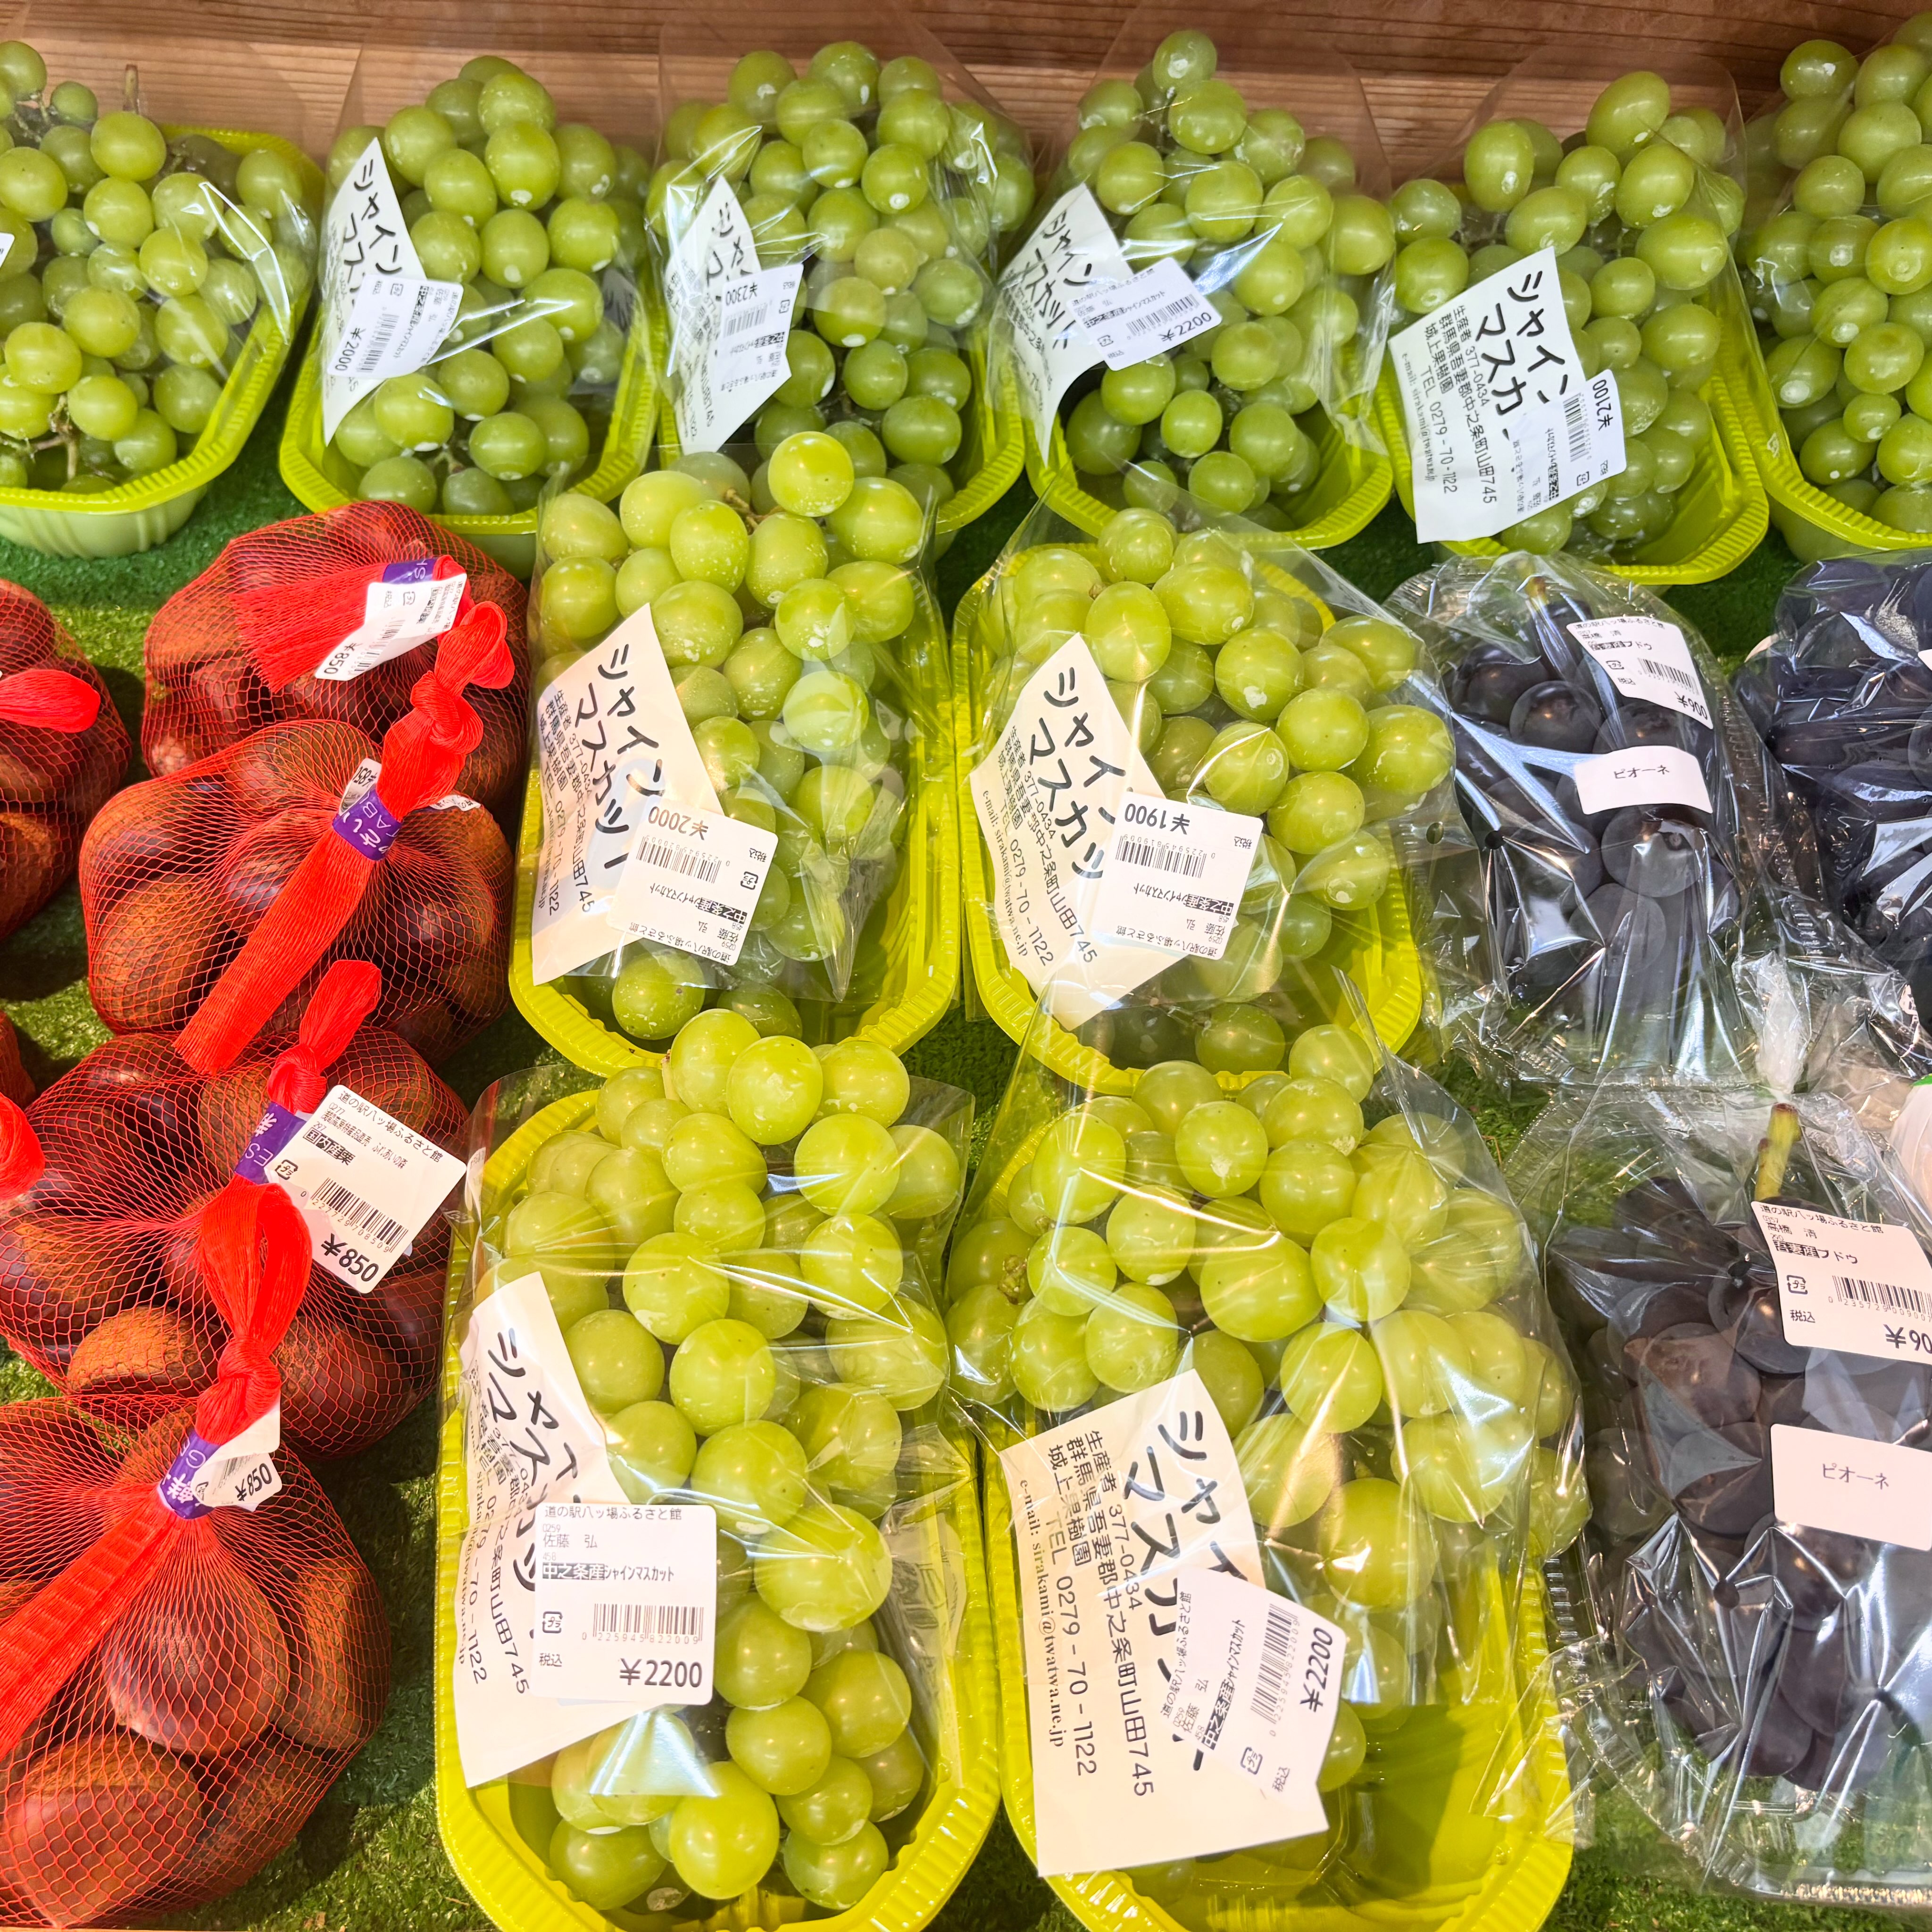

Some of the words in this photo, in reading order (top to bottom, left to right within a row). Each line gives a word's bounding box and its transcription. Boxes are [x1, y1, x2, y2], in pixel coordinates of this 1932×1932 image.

[354, 158, 402, 275] シャイン
[725, 282, 758, 306] ¥2300
[1158, 312, 1212, 341] ¥2200
[334, 327, 366, 371] ¥2000
[1453, 305, 1472, 341] 生産者
[1466, 345, 1491, 407] 377-0434
[1421, 365, 1436, 398] TEL
[1592, 379, 1614, 431] ¥2100
[324, 643, 363, 675] ¥850
[554, 689, 572, 731] 生産者
[598, 643, 666, 797] シャイン
[1674, 691, 1708, 720] ¥900
[542, 764, 554, 799] TEL
[1009, 725, 1025, 769] 生産者
[1024, 771, 1056, 840] 377-0434
[1613, 764, 1670, 780] ピオーネ
[983, 790, 998, 827] e-mail:
[1030, 717, 1104, 879] マスカッ
[648, 806, 708, 841] ¥2000
[999, 800, 1009, 838] TEL
[1124, 803, 1190, 835] ¥1900
[749, 847, 767, 863] 税込
[1233, 836, 1252, 849] 税込
[313, 1121, 327, 1132] 297
[329, 1102, 345, 1116] 0277
[338, 1090, 443, 1162] 道の駅八ッ場ふるさと館
[302, 1126, 356, 1166] 国内産栗
[321, 1232, 379, 1282] ¥850
[1790, 1309, 1815, 1323] 税込
[488, 1327, 581, 1503] シャイ
[235, 1463, 272, 1502] ¥850
[1822, 1463, 1890, 1490] ピオーネ
[487, 1372, 552, 1639] マスカッ
[545, 1506, 682, 1521] 道の駅八ッ場ふるさと館
[1158, 1410, 1249, 1581] シャイ
[542, 1524, 561, 1533] 0259
[1046, 1510, 1067, 1566] TEL
[1084, 1430, 1117, 1492] 生産者
[1109, 1503, 1143, 1611] 377-0434
[542, 1533, 570, 1549] 佐藤
[584, 1534, 598, 1549] 弘
[542, 1552, 557, 1561] 458
[542, 1561, 675, 1582] 中之条産シャインマスカット
[1020, 1479, 1041, 1536] e-mail:
[1032, 1542, 1067, 1748] sirakami@twatwa.ne.jp
[539, 1653, 563, 1667] 税込
[619, 1657, 703, 1688] ¥2200
[1160, 1591, 1192, 1719] 道の駅八ッ場ふるさと館
[1299, 1626, 1333, 1713] ¥2200
[1180, 1702, 1200, 1733] 佐藤
[1194, 1679, 1209, 1693] 弘
[1272, 1766, 1291, 1793] 税込
